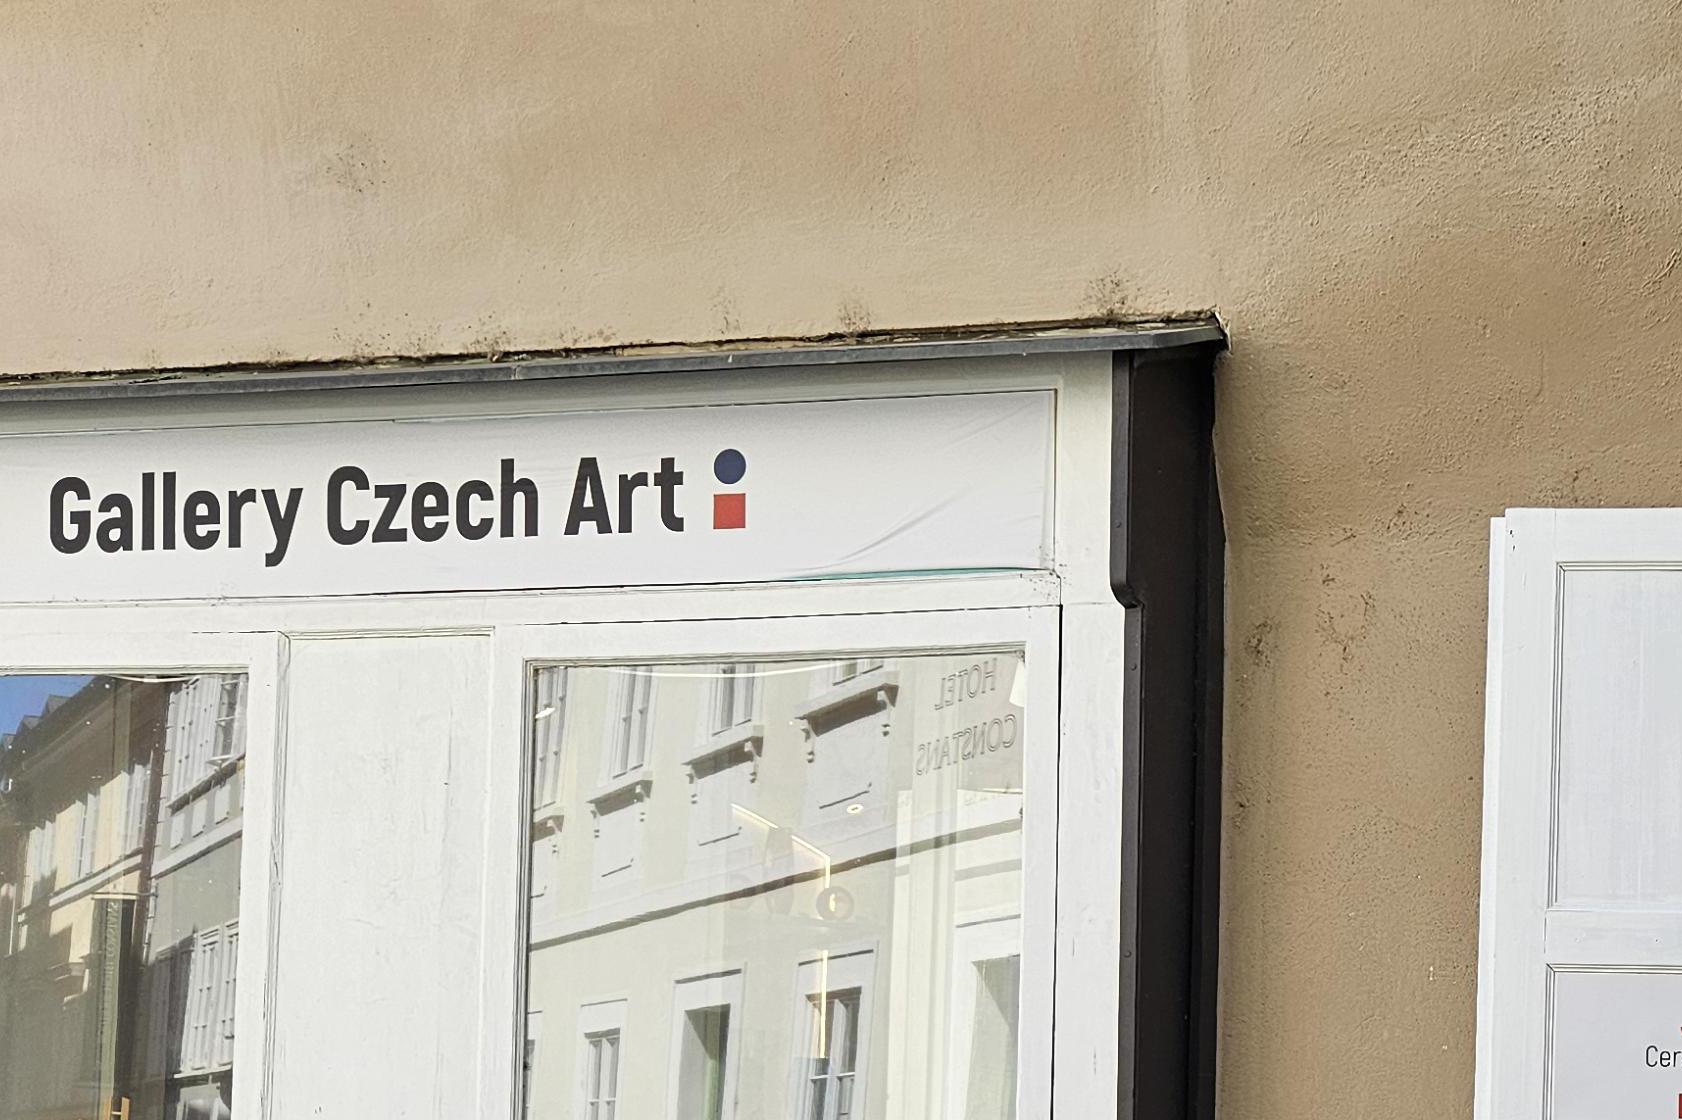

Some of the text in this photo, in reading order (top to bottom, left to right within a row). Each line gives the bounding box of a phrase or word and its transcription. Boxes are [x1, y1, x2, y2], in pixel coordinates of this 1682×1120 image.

[50, 457, 684, 567] Gallery Czech Art
